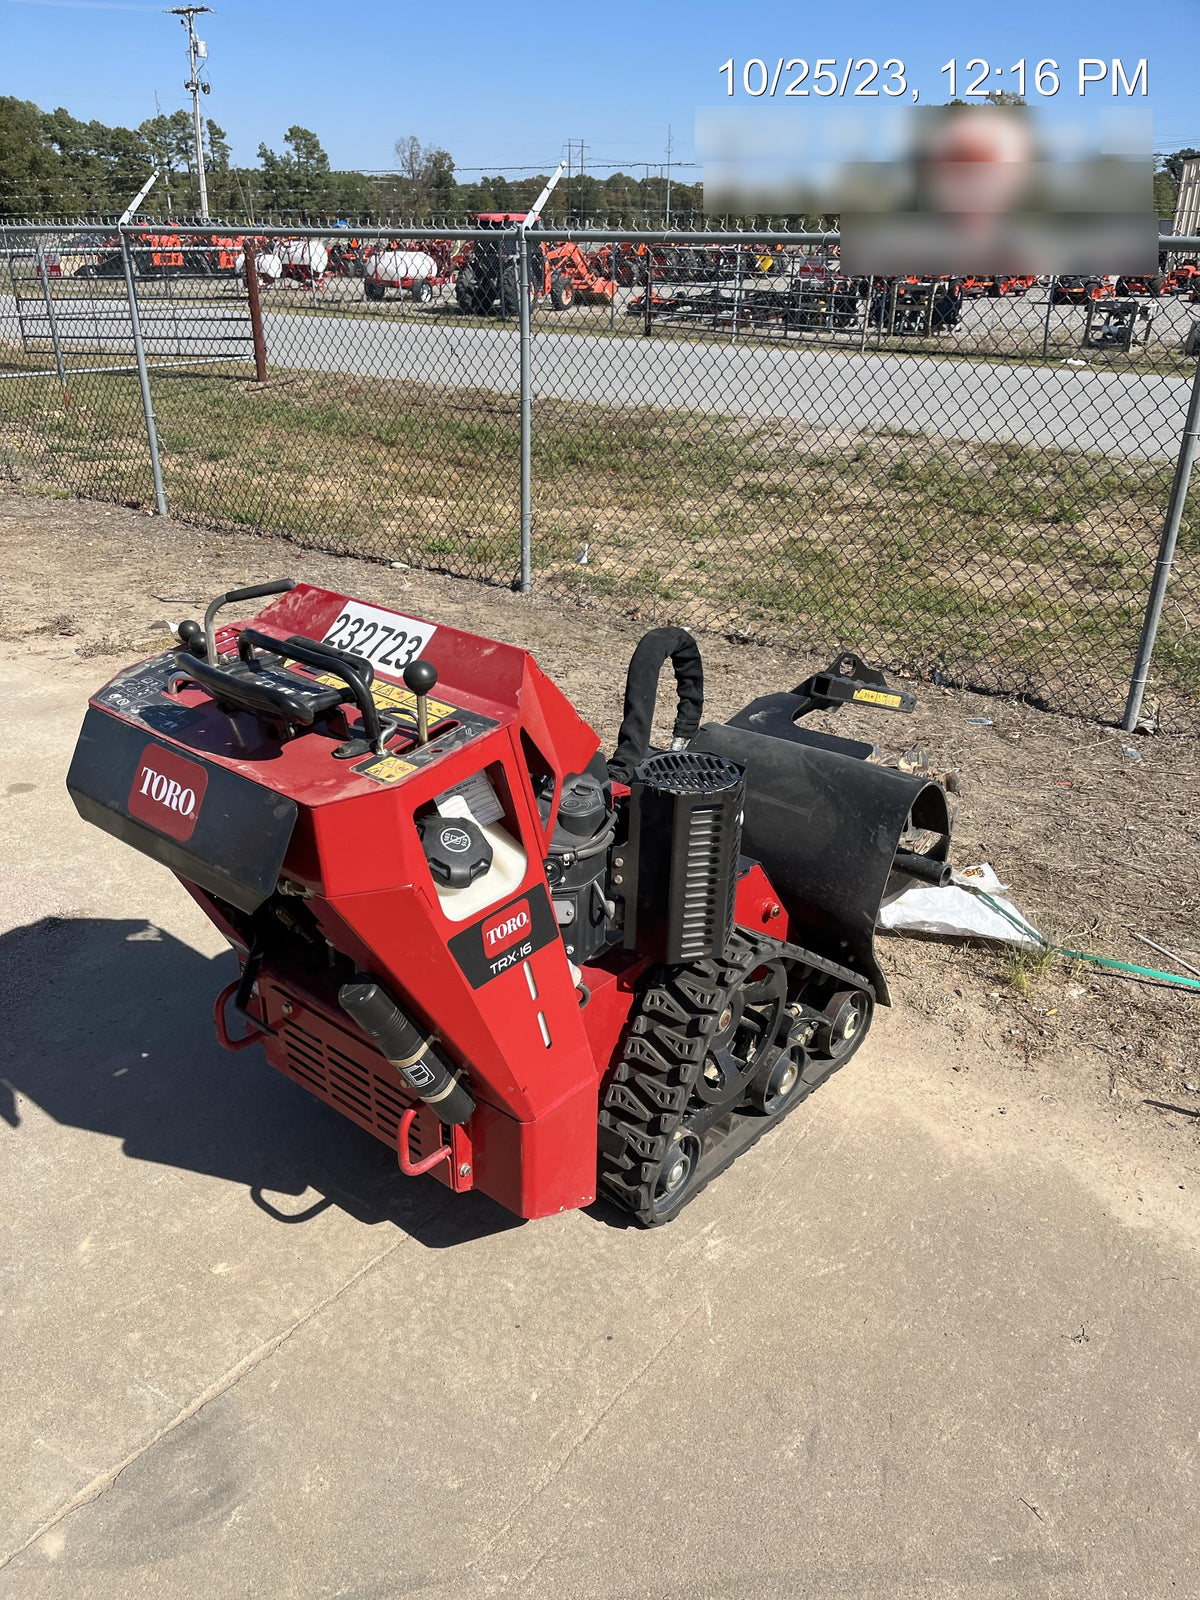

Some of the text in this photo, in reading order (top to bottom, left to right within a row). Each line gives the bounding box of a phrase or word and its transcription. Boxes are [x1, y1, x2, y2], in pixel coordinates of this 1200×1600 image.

[322, 613, 423, 670] 232723
[139, 766, 196, 816] TORO
[486, 911, 528, 946] TORO
